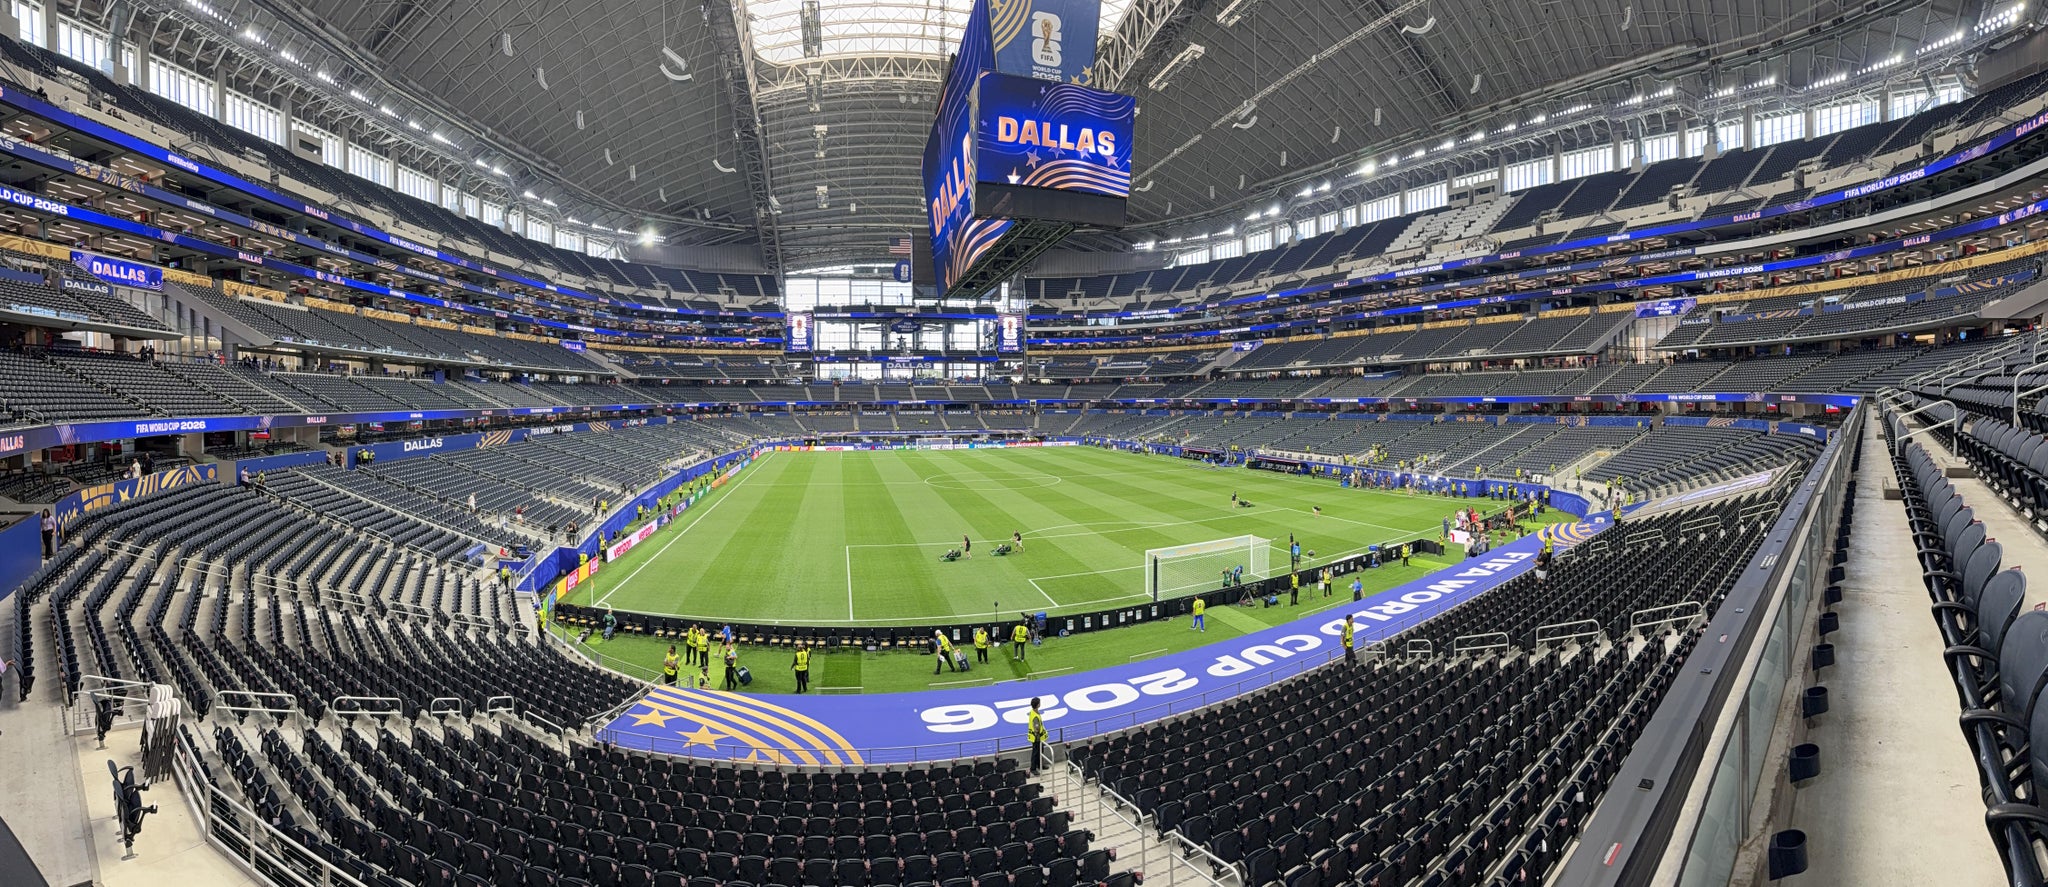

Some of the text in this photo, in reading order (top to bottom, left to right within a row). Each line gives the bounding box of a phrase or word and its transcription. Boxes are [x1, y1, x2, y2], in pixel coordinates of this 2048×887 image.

[1040, 54, 1054, 62] FIFA
[1032, 65, 1052, 74] WORLD
[998, 116, 1115, 156] DALLAS
[932, 131, 971, 237] DALLA
[1844, 169, 1925, 199] FIFA WORLD CUP 2026
[12, 192, 33, 206] CUP
[34, 198, 68, 216] 2026
[305, 205, 328, 220] DALLAS
[1733, 211, 1761, 223] DALLAS
[1903, 235, 1931, 247] DALLAS
[325, 243, 349, 256] DALLAS
[1500, 251, 1520, 260] DALLAS
[238, 252, 263, 265] DALLAS
[93, 261, 146, 283] DALLAS
[1546, 265, 1571, 273] DALLAS
[1695, 272, 1709, 280] FIFA
[1709, 270, 1730, 278] WORLD
[1743, 265, 1764, 274] 2026
[64, 280, 108, 294] DALLAS
[1552, 288, 1572, 296] DALLAS
[1843, 295, 1906, 311] FIFA WORLD CUP 2026
[306, 415, 327, 424] DALLAS
[136, 421, 206, 434] FIFA WORLD CUP 2026
[404, 438, 443, 452] DALLAS
[638, 524, 654, 541] verizon
[613, 539, 632, 558] verizon
[920, 551, 1536, 733] FIFA WORLD CUP 2026
